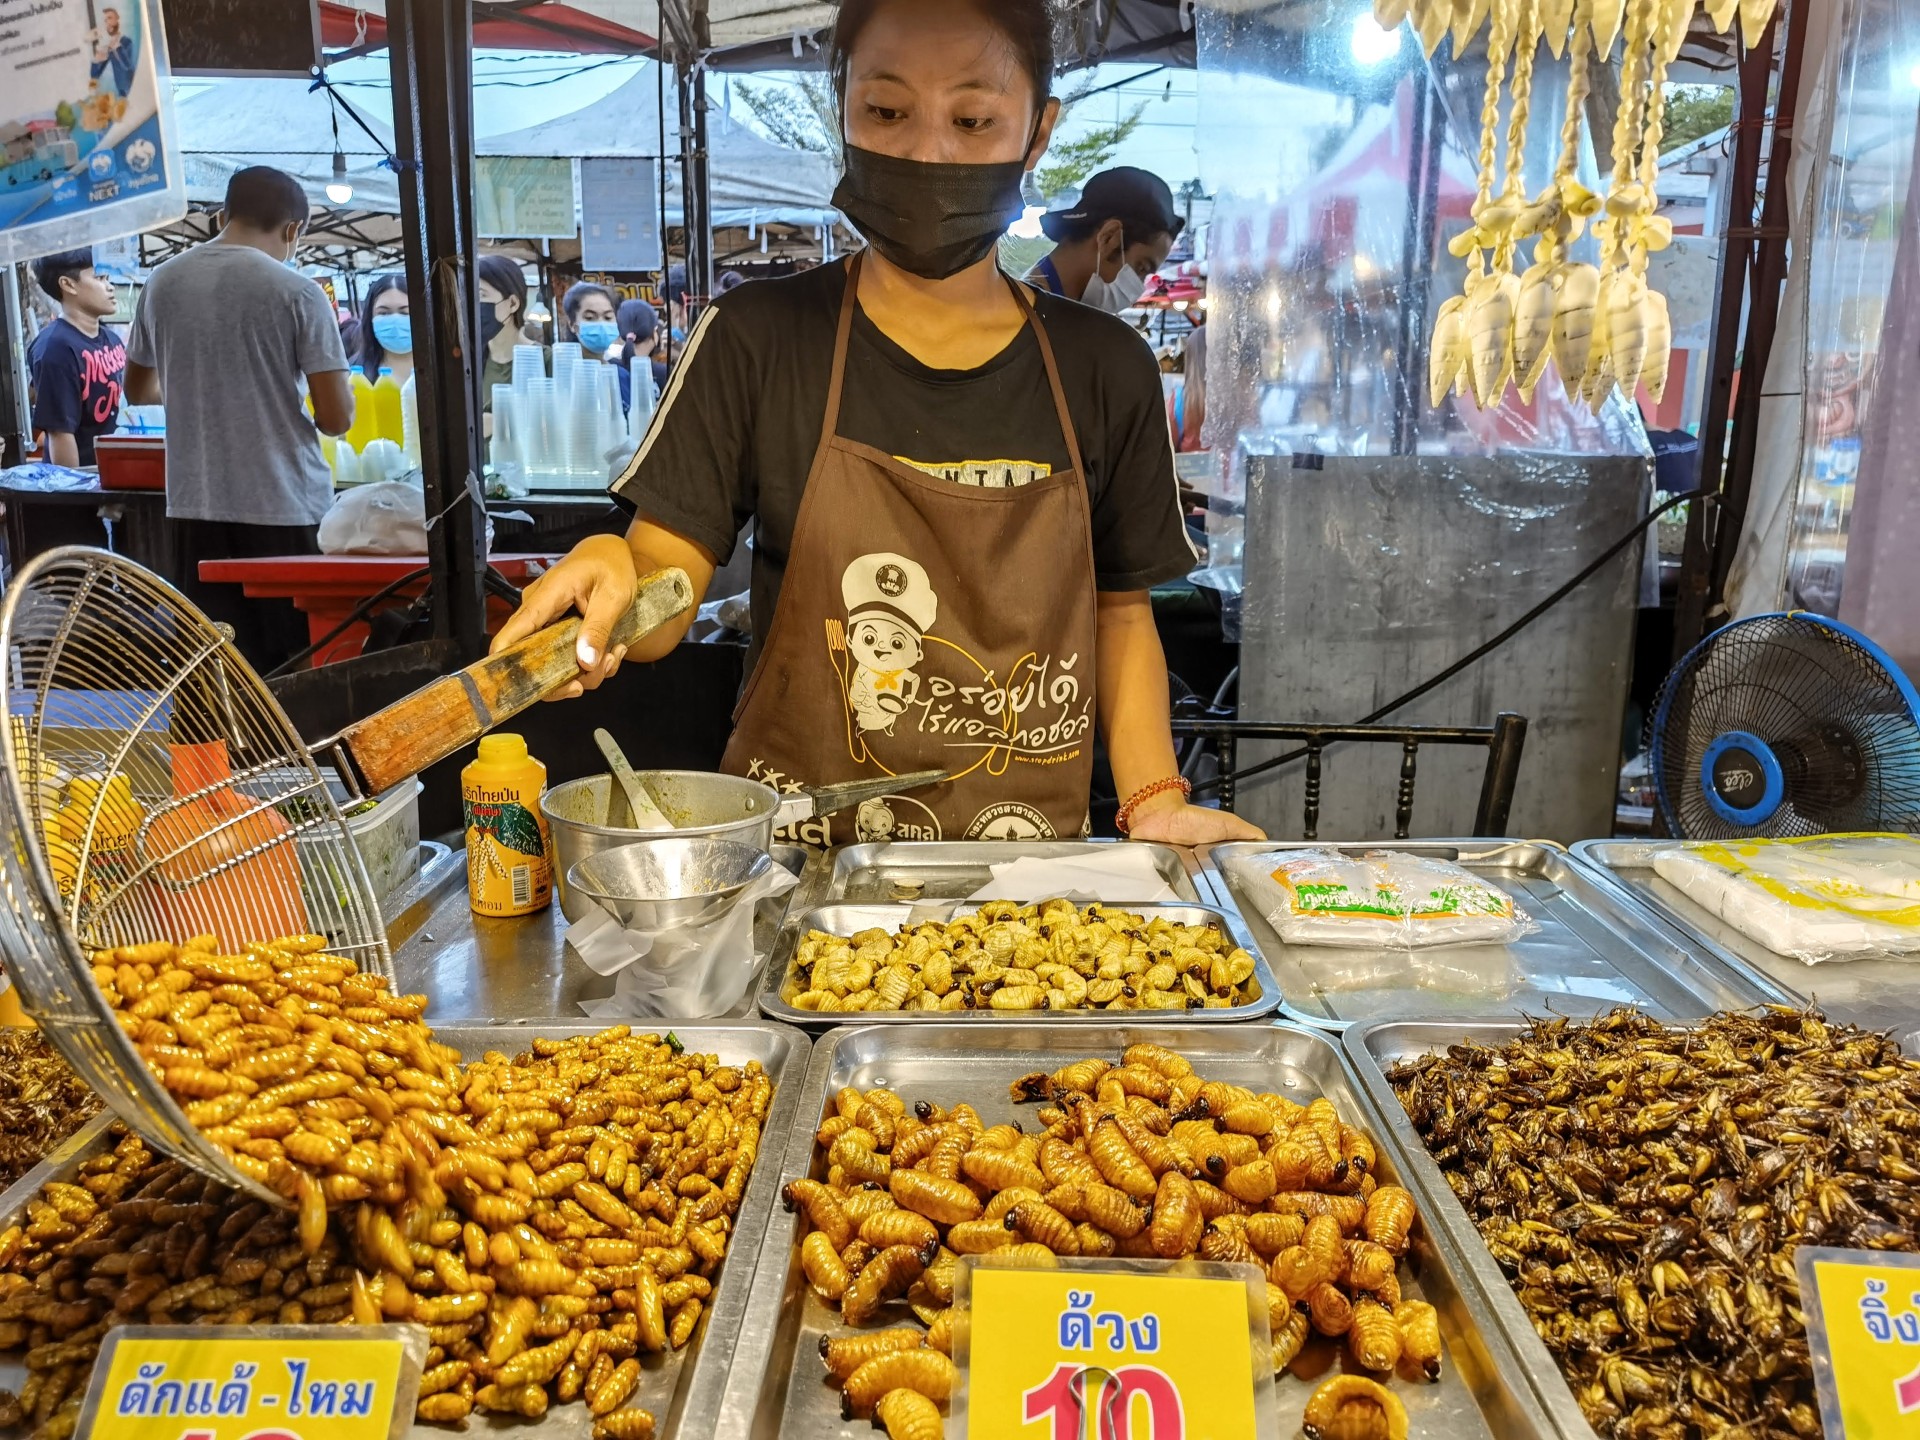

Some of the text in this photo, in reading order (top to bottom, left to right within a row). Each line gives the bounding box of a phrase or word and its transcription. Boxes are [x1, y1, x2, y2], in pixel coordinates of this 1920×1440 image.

[928, 652, 1080, 716] อร่อยได้
[463, 785, 520, 803] ริกไทยป่น
[1059, 1291, 1160, 1352] ด้วง
[1860, 1280, 1920, 1342] จิ้ง
[1023, 1363, 1185, 1440] 10
